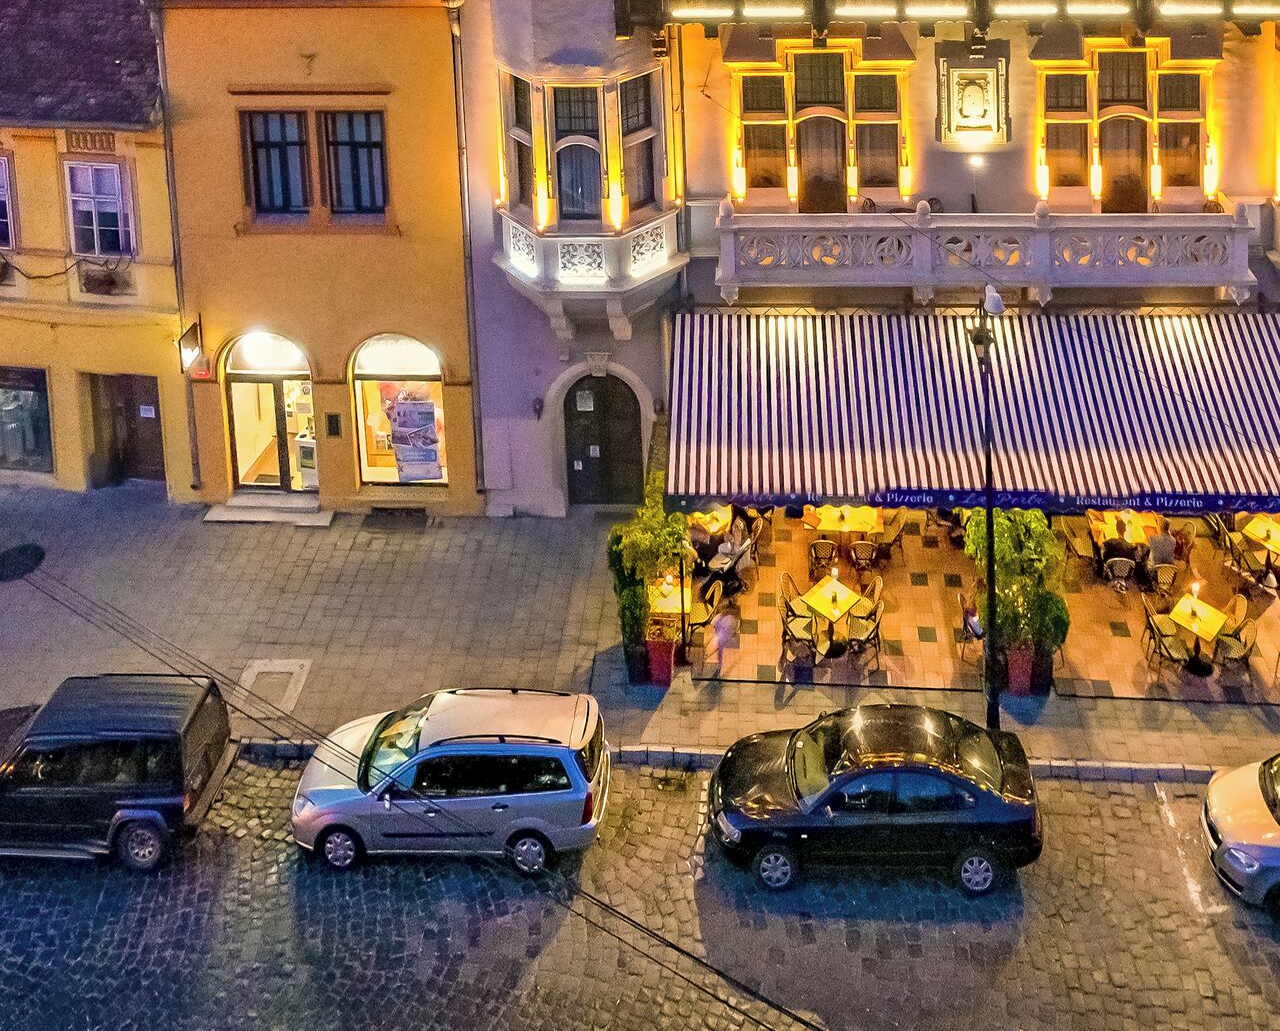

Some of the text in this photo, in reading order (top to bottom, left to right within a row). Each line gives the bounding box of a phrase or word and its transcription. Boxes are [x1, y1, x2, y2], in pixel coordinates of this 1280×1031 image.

[875, 493, 883, 503] &
[887, 492, 933, 504] Pizzeria
[1144, 496, 1152, 507] &
[1156, 496, 1203, 508] Pizzeria
